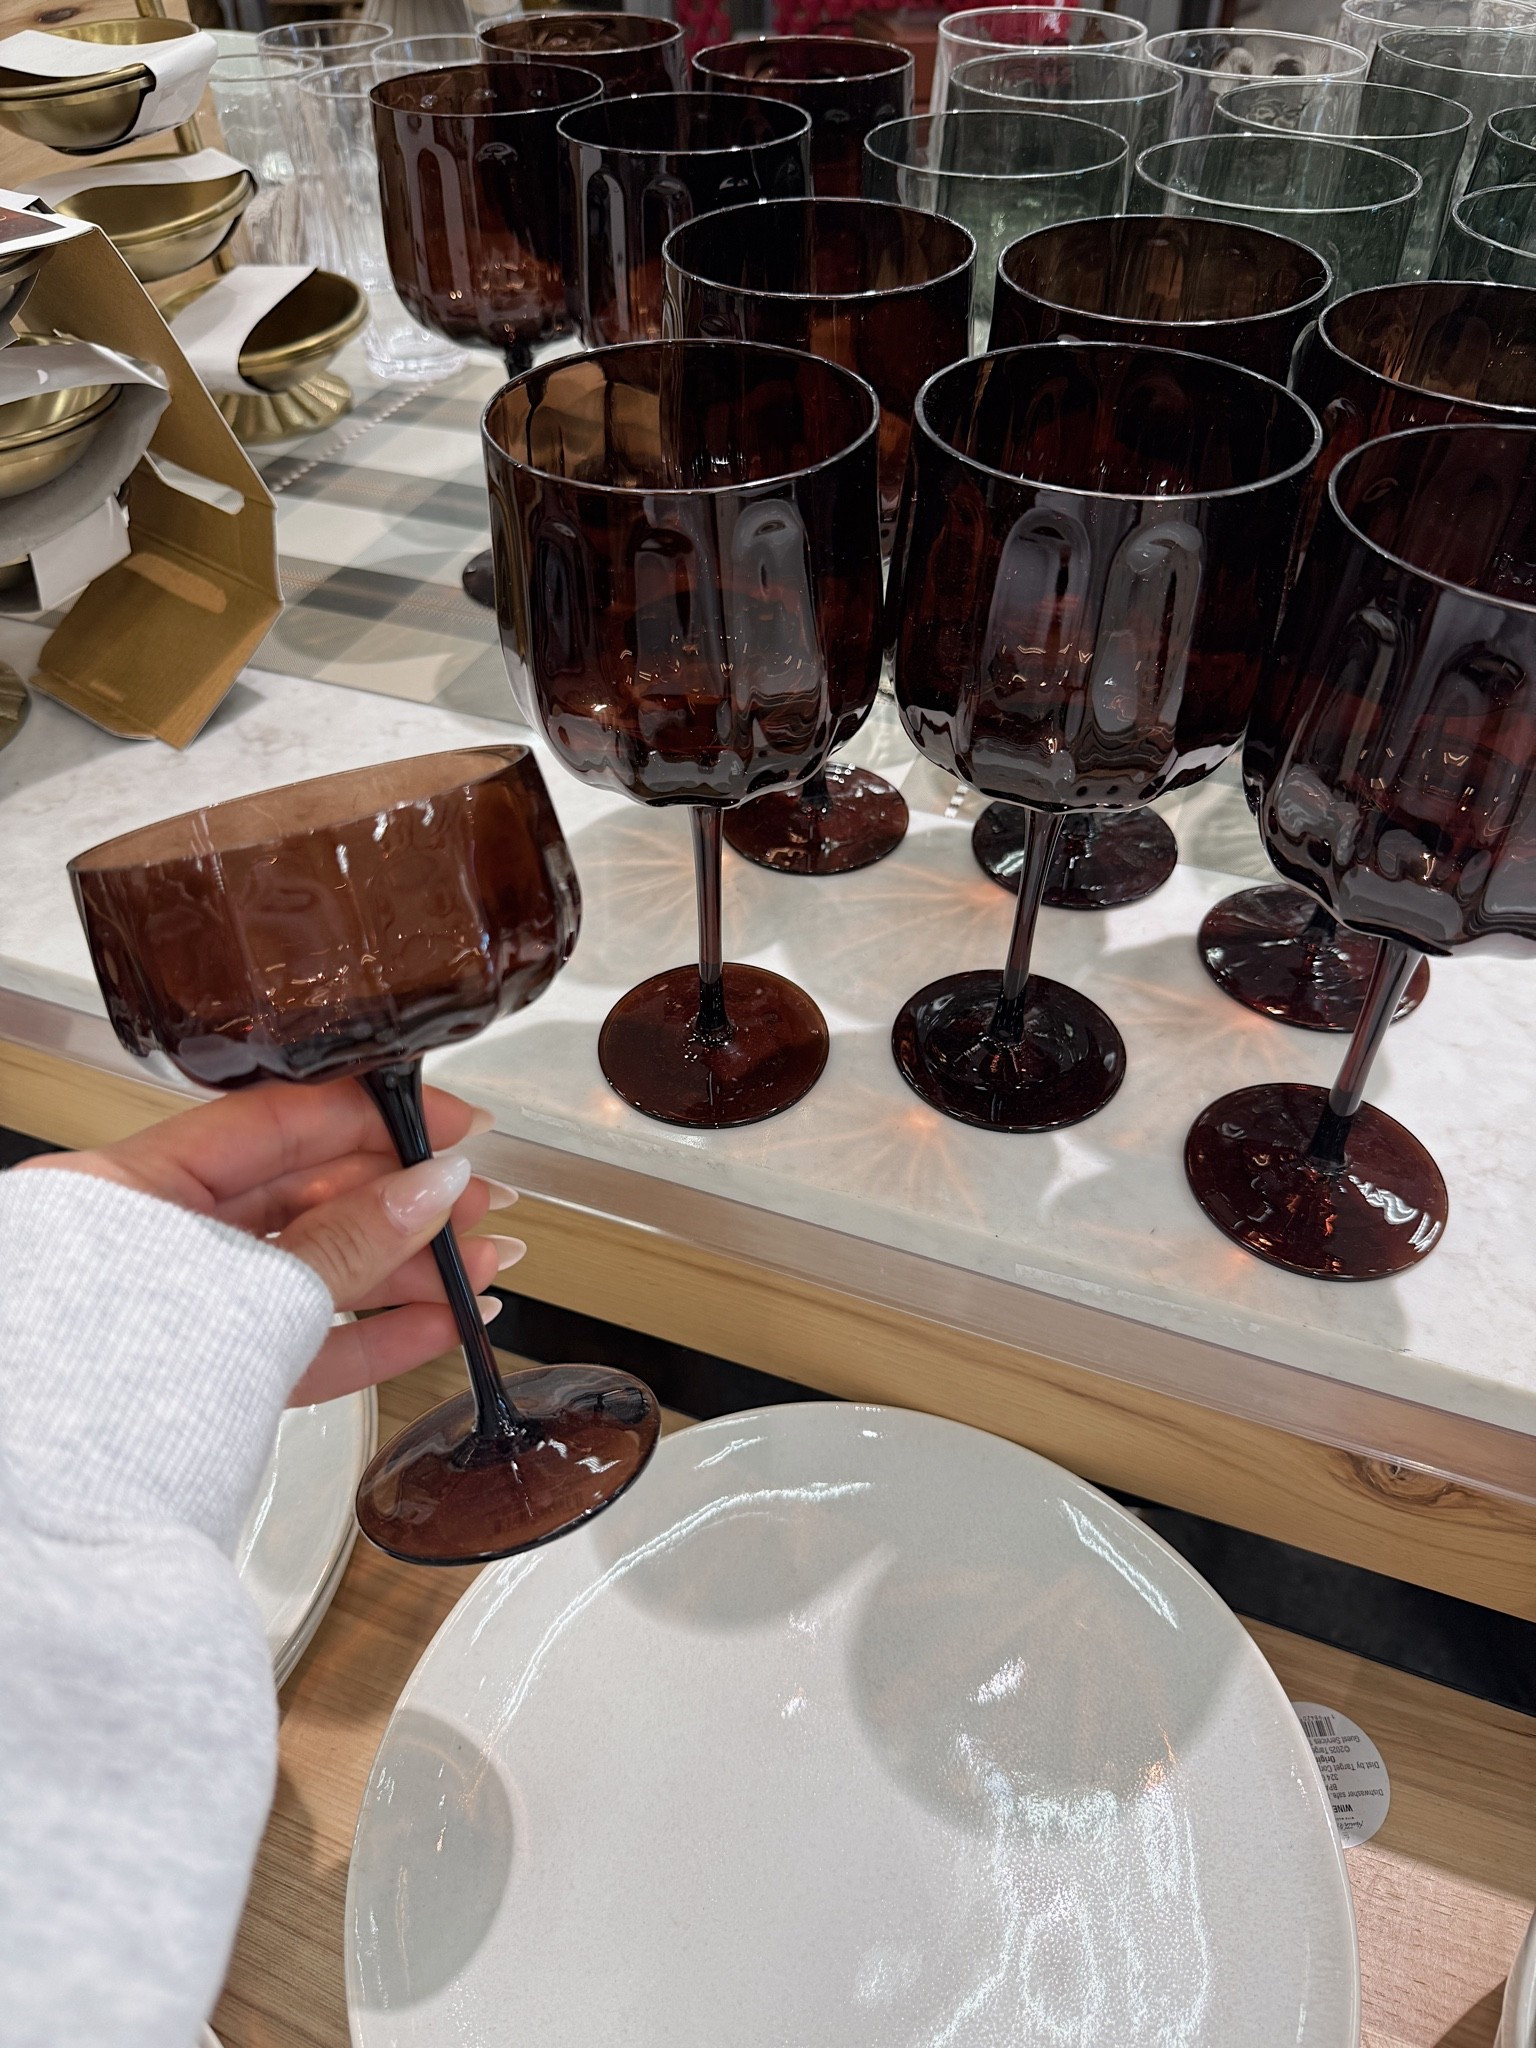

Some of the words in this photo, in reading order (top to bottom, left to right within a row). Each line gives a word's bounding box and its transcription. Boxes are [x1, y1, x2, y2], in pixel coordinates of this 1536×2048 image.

[1313, 1737, 1341, 1745] Services
[1341, 1735, 1360, 1743] Guest
[1333, 1763, 1356, 1772] Target
[1356, 1761, 1365, 1770] by
[1347, 1788, 1384, 1797] Dishwasher
[1332, 1804, 1353, 1813] WINE
